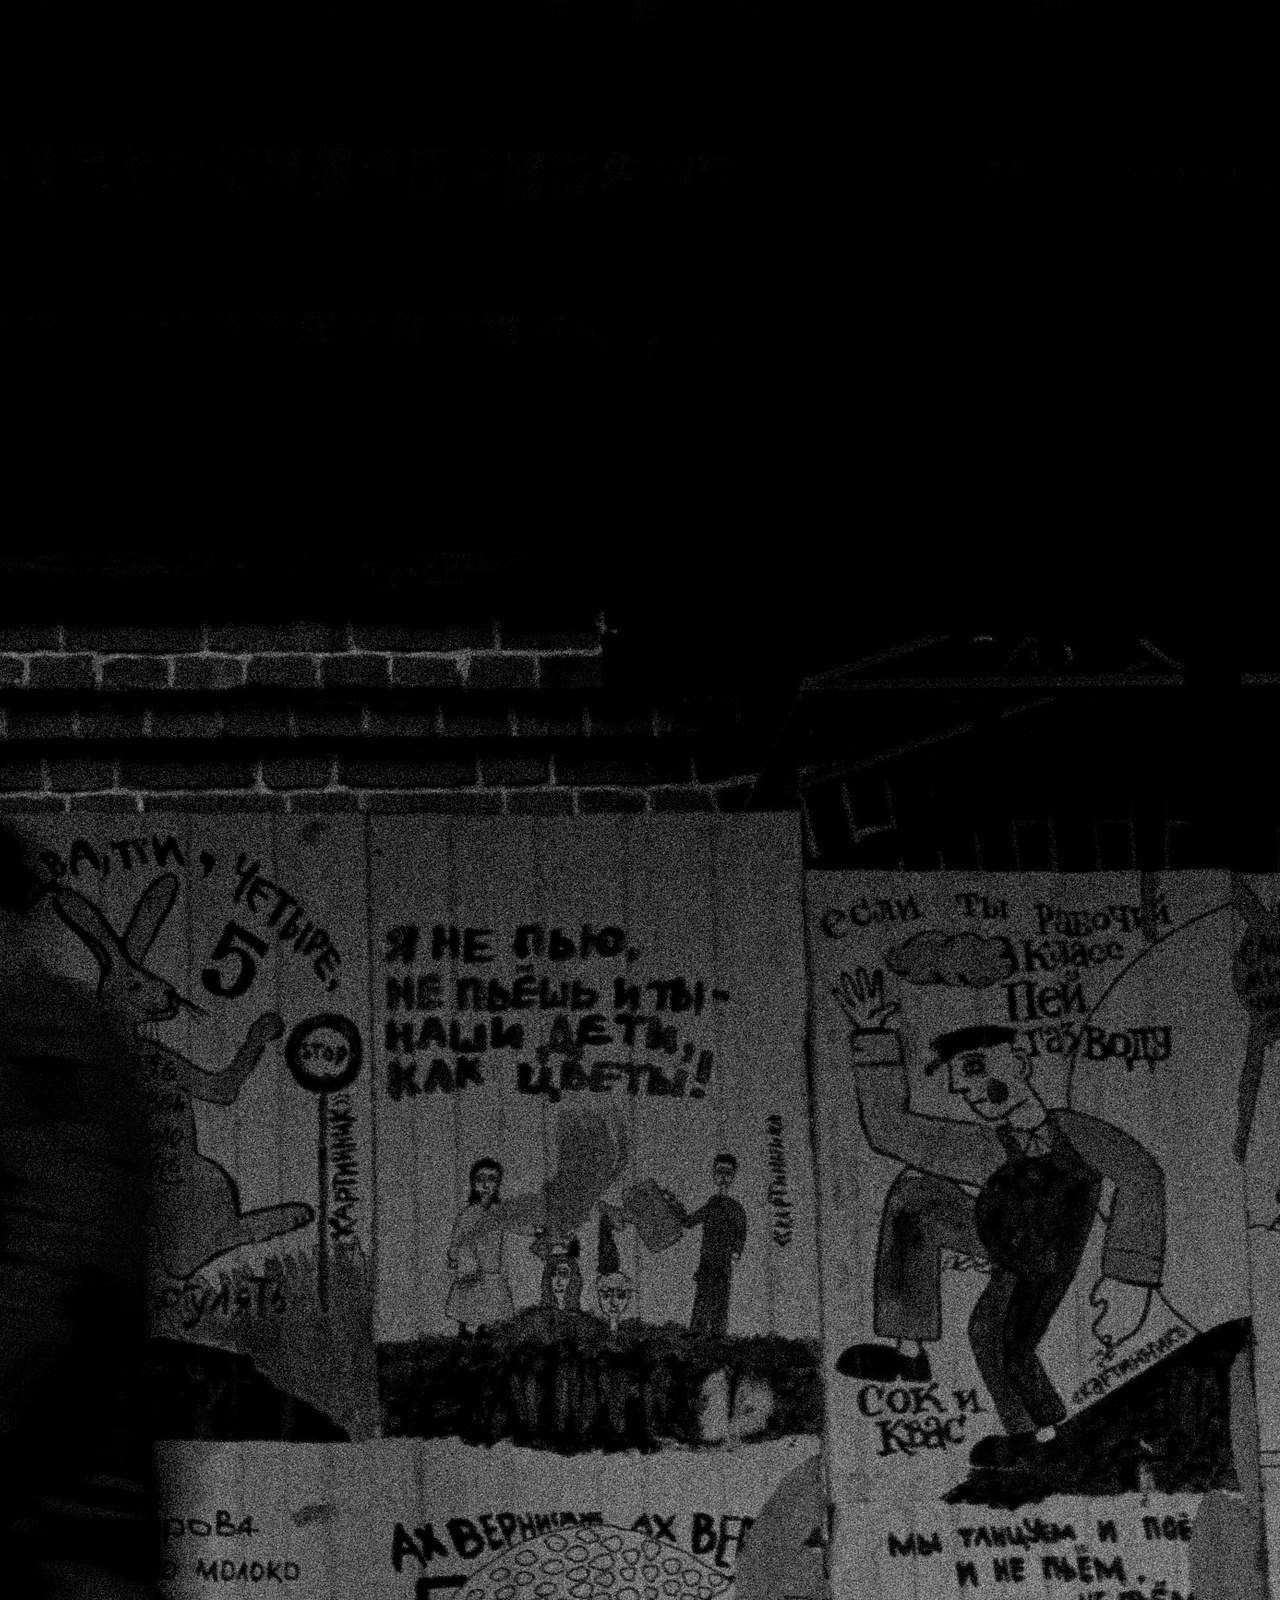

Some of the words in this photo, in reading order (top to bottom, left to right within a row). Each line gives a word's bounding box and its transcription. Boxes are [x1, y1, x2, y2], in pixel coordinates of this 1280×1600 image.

[40, 838, 110, 880] ВА,
[201, 920, 270, 998] 5
[385, 924, 419, 964] Я
[431, 925, 494, 963] НЕ
[385, 973, 442, 1012] НЕ
[614, 976, 640, 1012] И
[385, 1015, 524, 1053] НАШИ
[387, 1054, 484, 1102] КАК
[161, 1276, 287, 1331] ОГУЛЯТЬ
[162, 1509, 260, 1544] РОВА
[631, 1512, 676, 1543] АХ
[1142, 1512, 1192, 1542] ПОЁ
[195, 1558, 301, 1584] МОЛОКО
[956, 1560, 978, 1588] И
[993, 1556, 1025, 1583] НЕ
